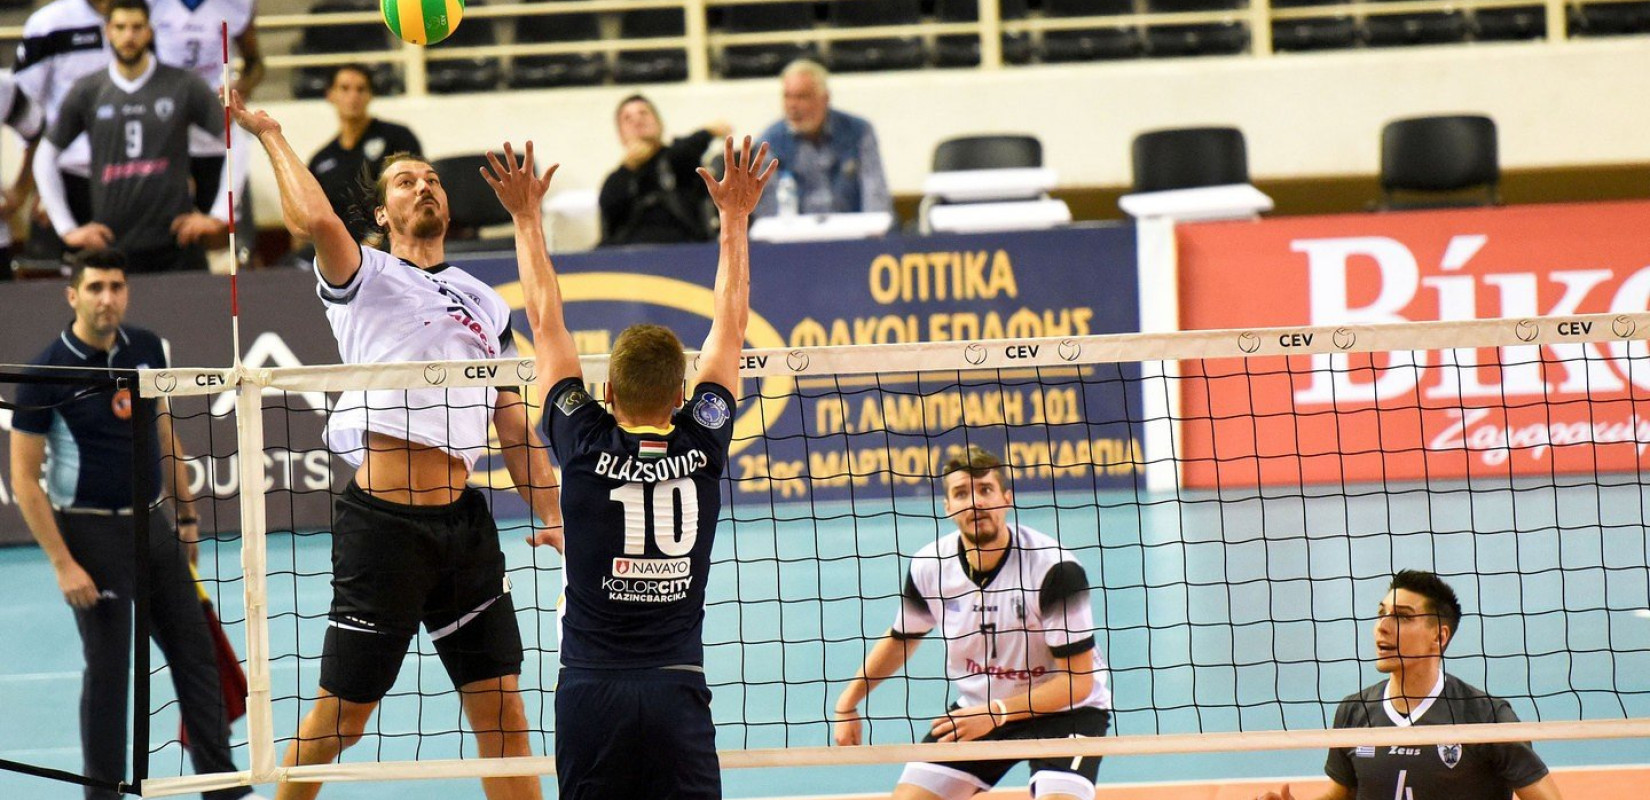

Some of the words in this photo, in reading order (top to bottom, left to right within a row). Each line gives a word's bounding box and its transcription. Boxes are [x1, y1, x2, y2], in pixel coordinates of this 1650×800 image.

[125, 120, 142, 158] 9
[868, 248, 1018, 304] ΟΠΤΙΚΑ
[1557, 320, 1593, 336] CEV
[1278, 332, 1314, 348] CEV
[1005, 345, 1040, 360] CEV
[464, 365, 498, 379] CEV
[1031, 387, 1080, 426] 101
[609, 476, 699, 557] 10
[631, 560, 688, 575] NAVAYO
[608, 590, 687, 603] KAZINCBARCIKA
[980, 623, 997, 659] 7
[1388, 745, 1421, 756] Zeus
